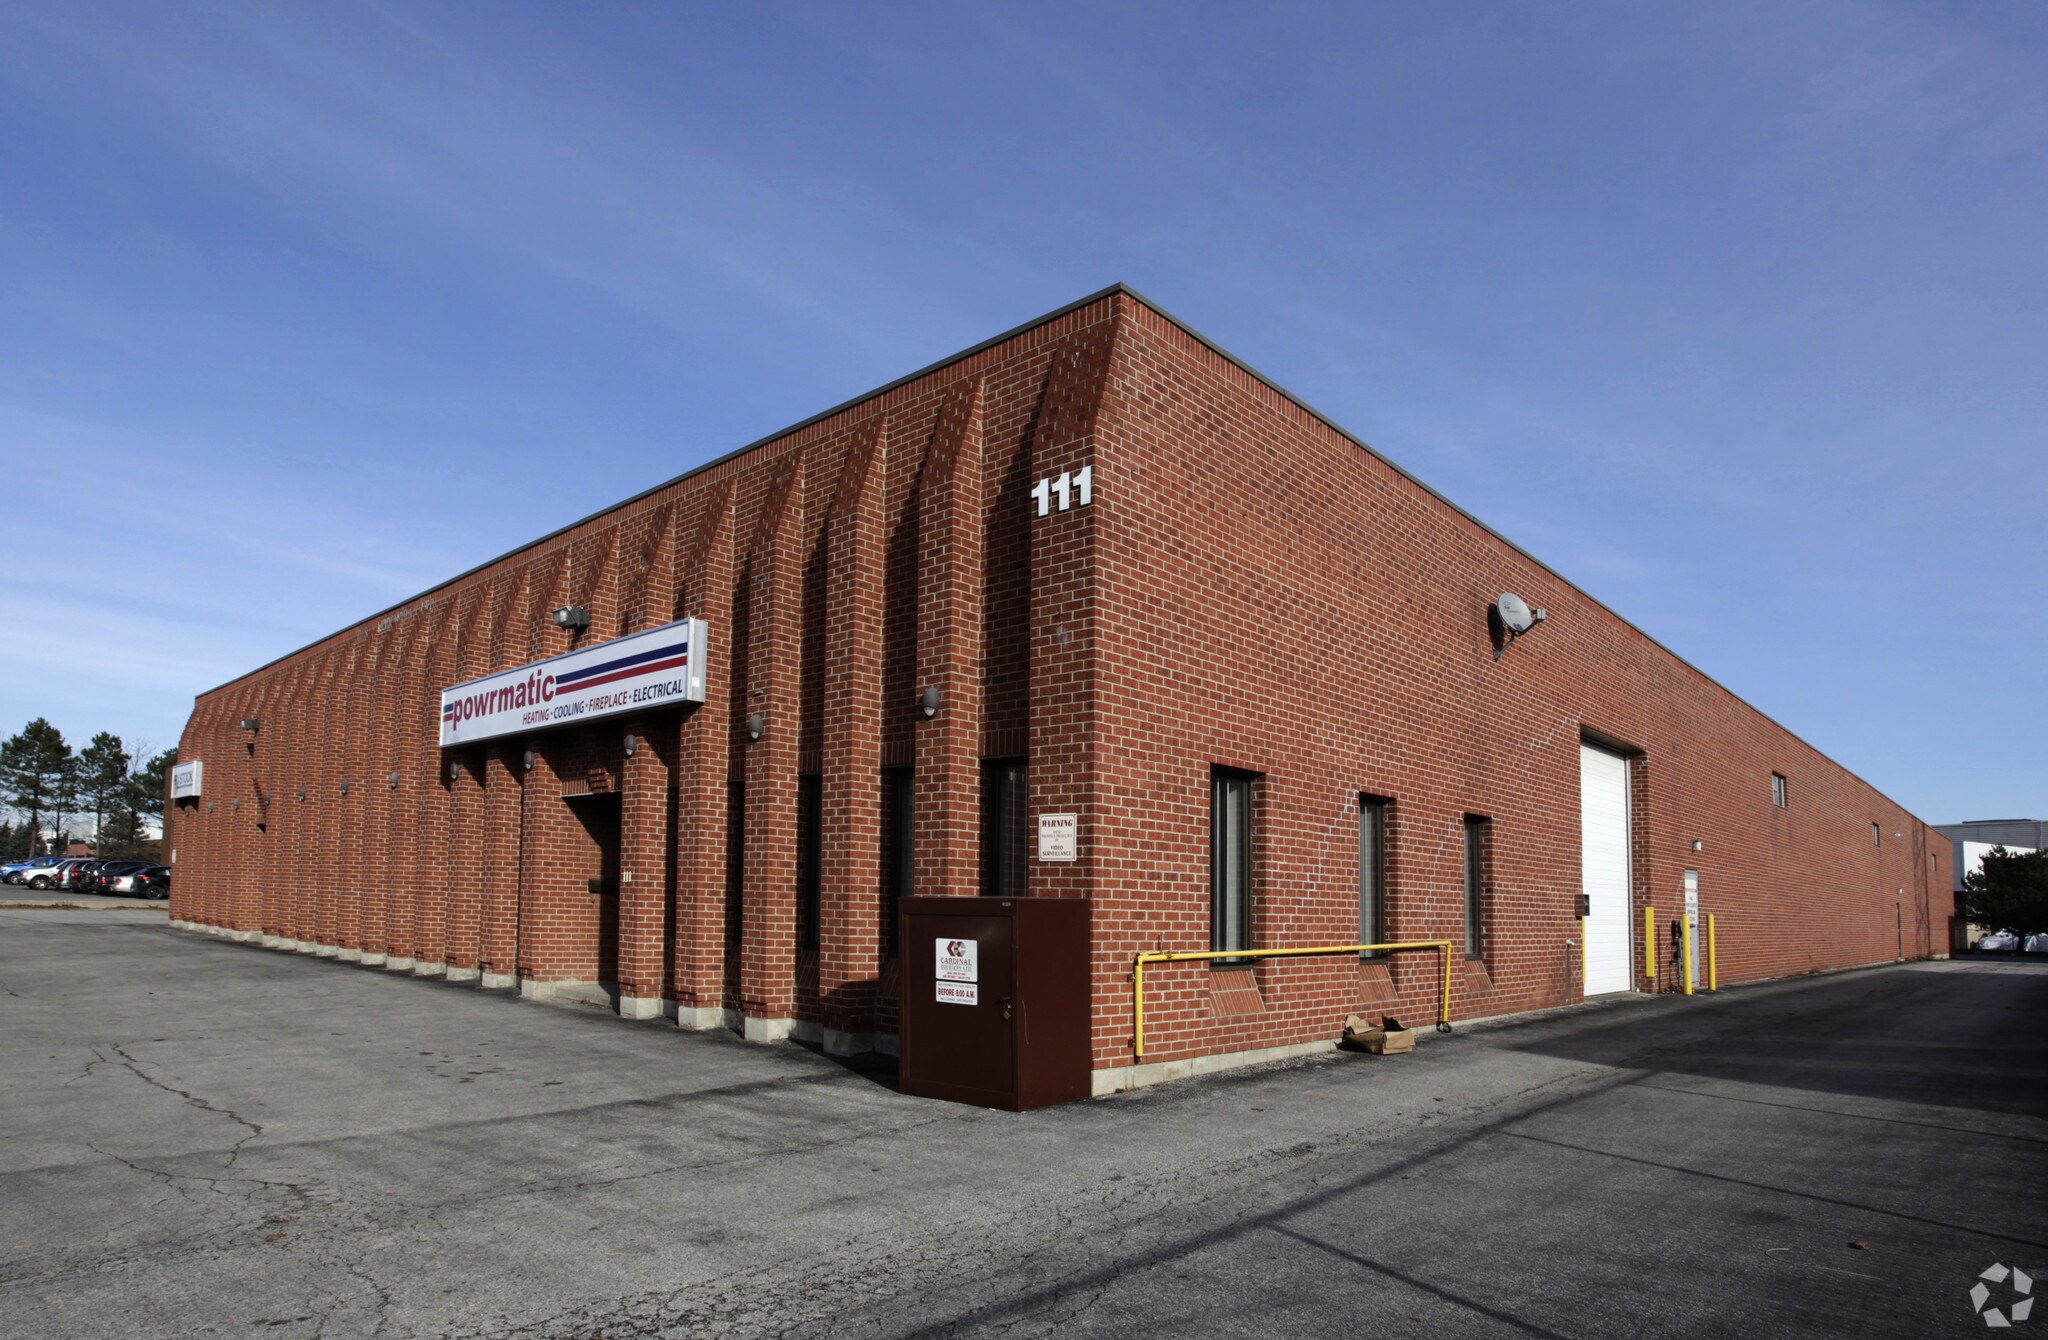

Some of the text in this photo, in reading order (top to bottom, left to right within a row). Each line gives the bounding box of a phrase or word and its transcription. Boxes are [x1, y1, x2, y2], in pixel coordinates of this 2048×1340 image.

[1031, 465, 1091, 517] 111
[453, 669, 554, 731] powrmatic
[522, 679, 683, 725] HEATING COOLING FIREPLACE ELECTRICAL
[1042, 819, 1073, 828] WARNING
[940, 956, 972, 966] CARDINAL
[938, 987, 955, 996] BEFORE
